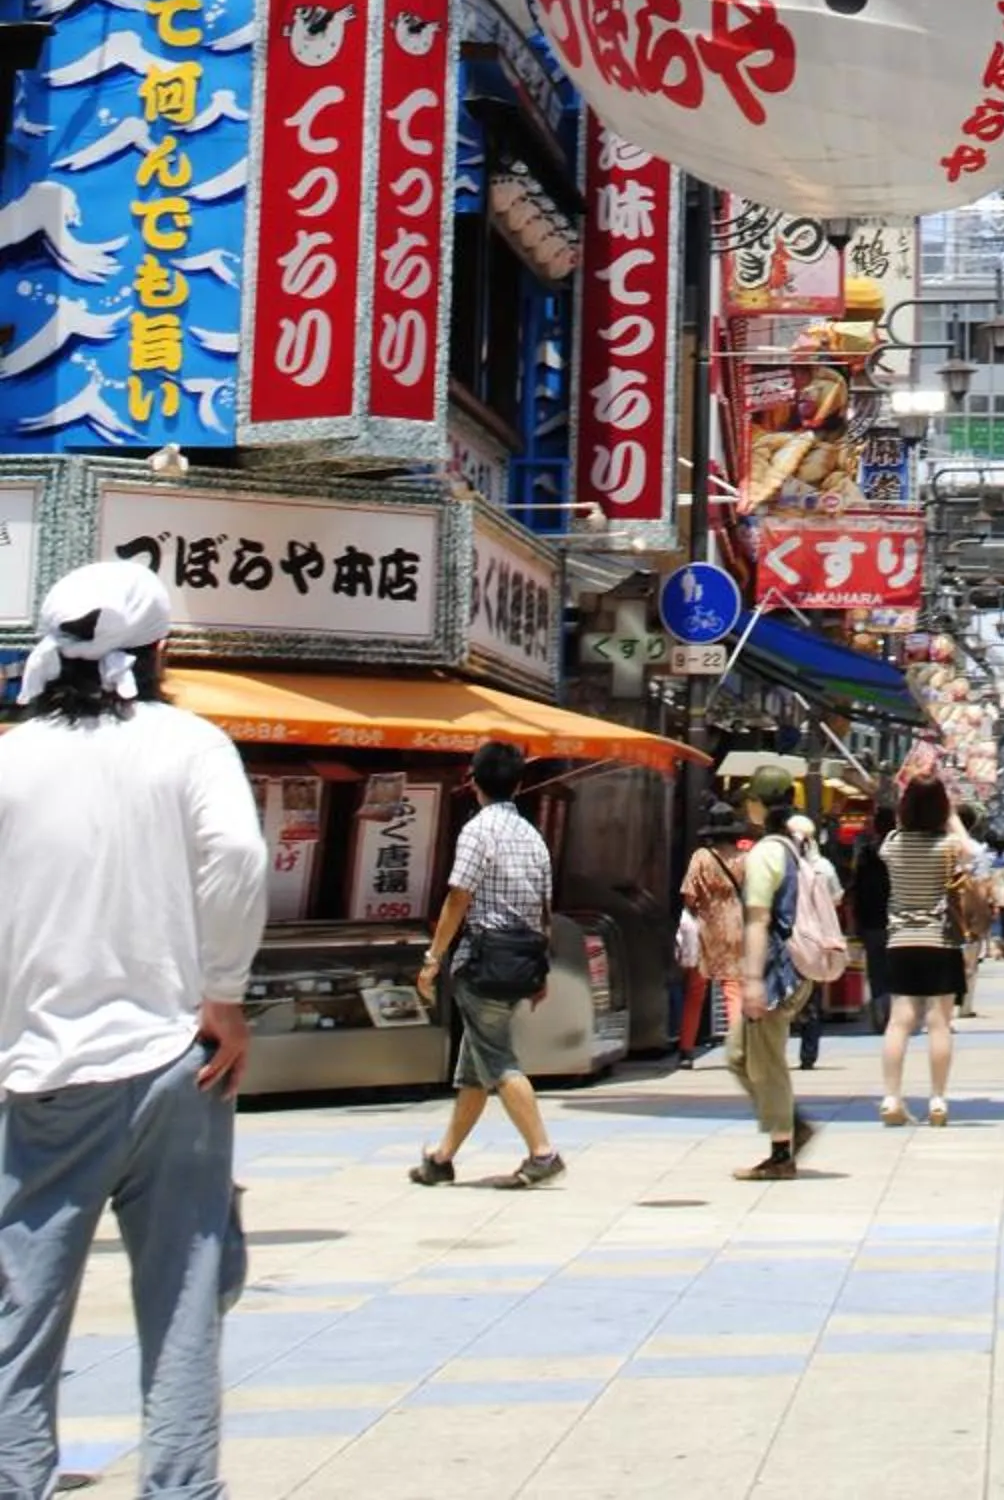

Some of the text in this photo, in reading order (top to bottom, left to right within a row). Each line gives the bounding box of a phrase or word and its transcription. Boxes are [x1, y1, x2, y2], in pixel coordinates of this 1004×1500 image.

[115, 531, 421, 602] づぼらや本店
[764, 536, 919, 589] くすり
[796, 591, 884, 605] TAKAHARA
[593, 636, 665, 659] くすり
[674, 653, 723, 668] 9-22
